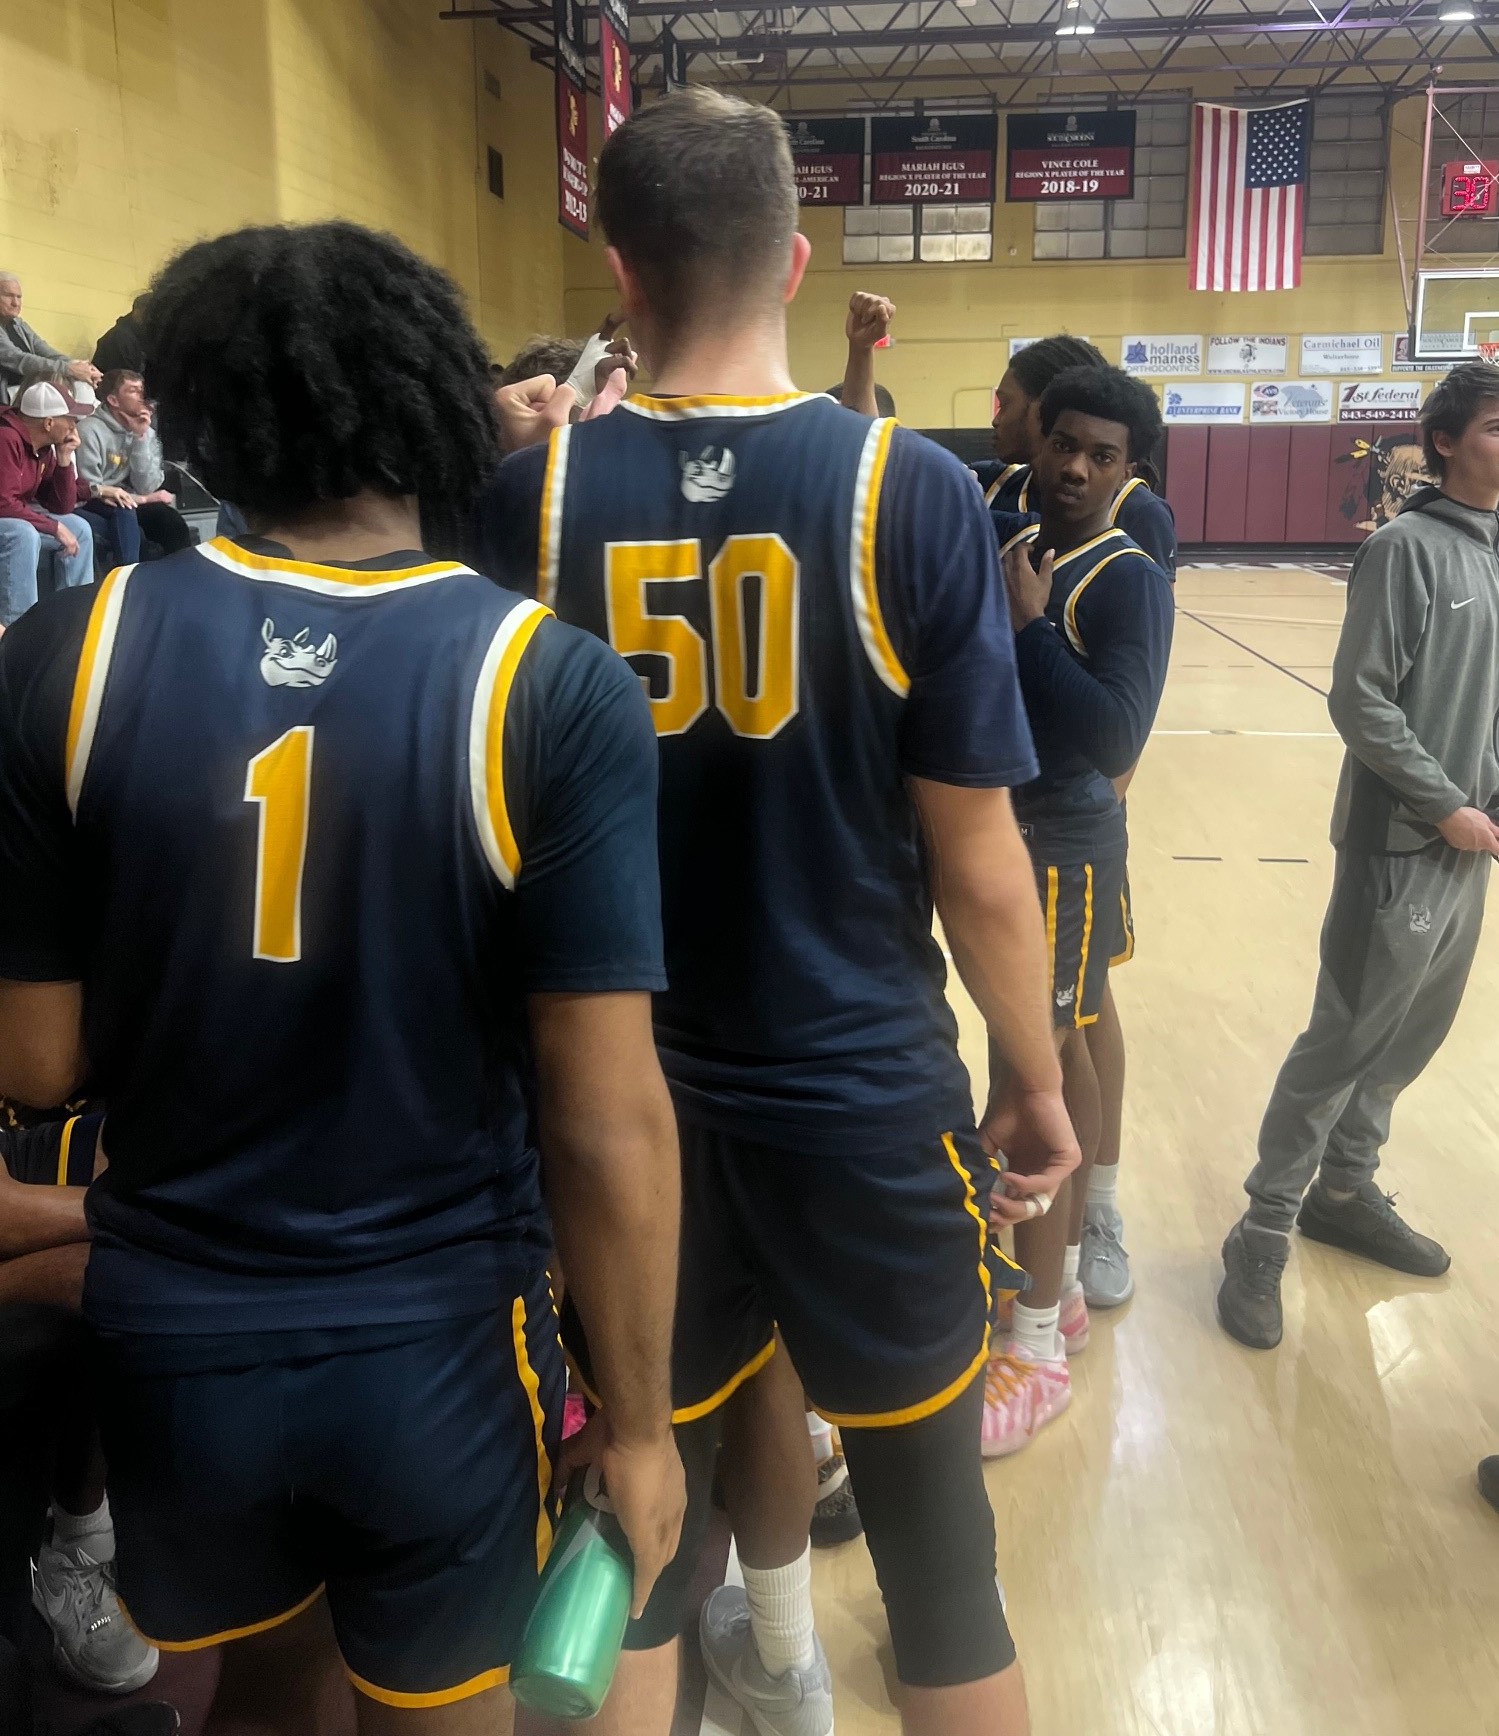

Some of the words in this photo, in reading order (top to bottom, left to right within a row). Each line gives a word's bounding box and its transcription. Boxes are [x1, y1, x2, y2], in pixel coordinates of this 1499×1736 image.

[901, 163, 940, 172] MARIAH
[942, 162, 965, 171] IGUS
[1041, 160, 1071, 169] VINCE
[1073, 159, 1099, 168] COLE
[1051, 170, 1077, 178] PLAYER
[904, 183, 960, 196] 2020-21
[1040, 180, 1099, 194] 2018-19
[1452, 175, 1489, 211] 30
[1210, 337, 1240, 346] FOLLOW
[1258, 337, 1286, 346] INDIANS
[1303, 338, 1360, 349] Carmichael
[1364, 337, 1380, 348] Oil
[1150, 342, 1198, 355] holland
[1149, 354, 1200, 364] maness
[1125, 365, 1200, 373] ORTHODONTICS
[1341, 383, 1369, 403] 1st
[1368, 387, 1420, 402] federal
[1341, 410, 1416, 419] 843-549-2418
[604, 532, 800, 740] 50
[243, 725, 315, 964] 1
